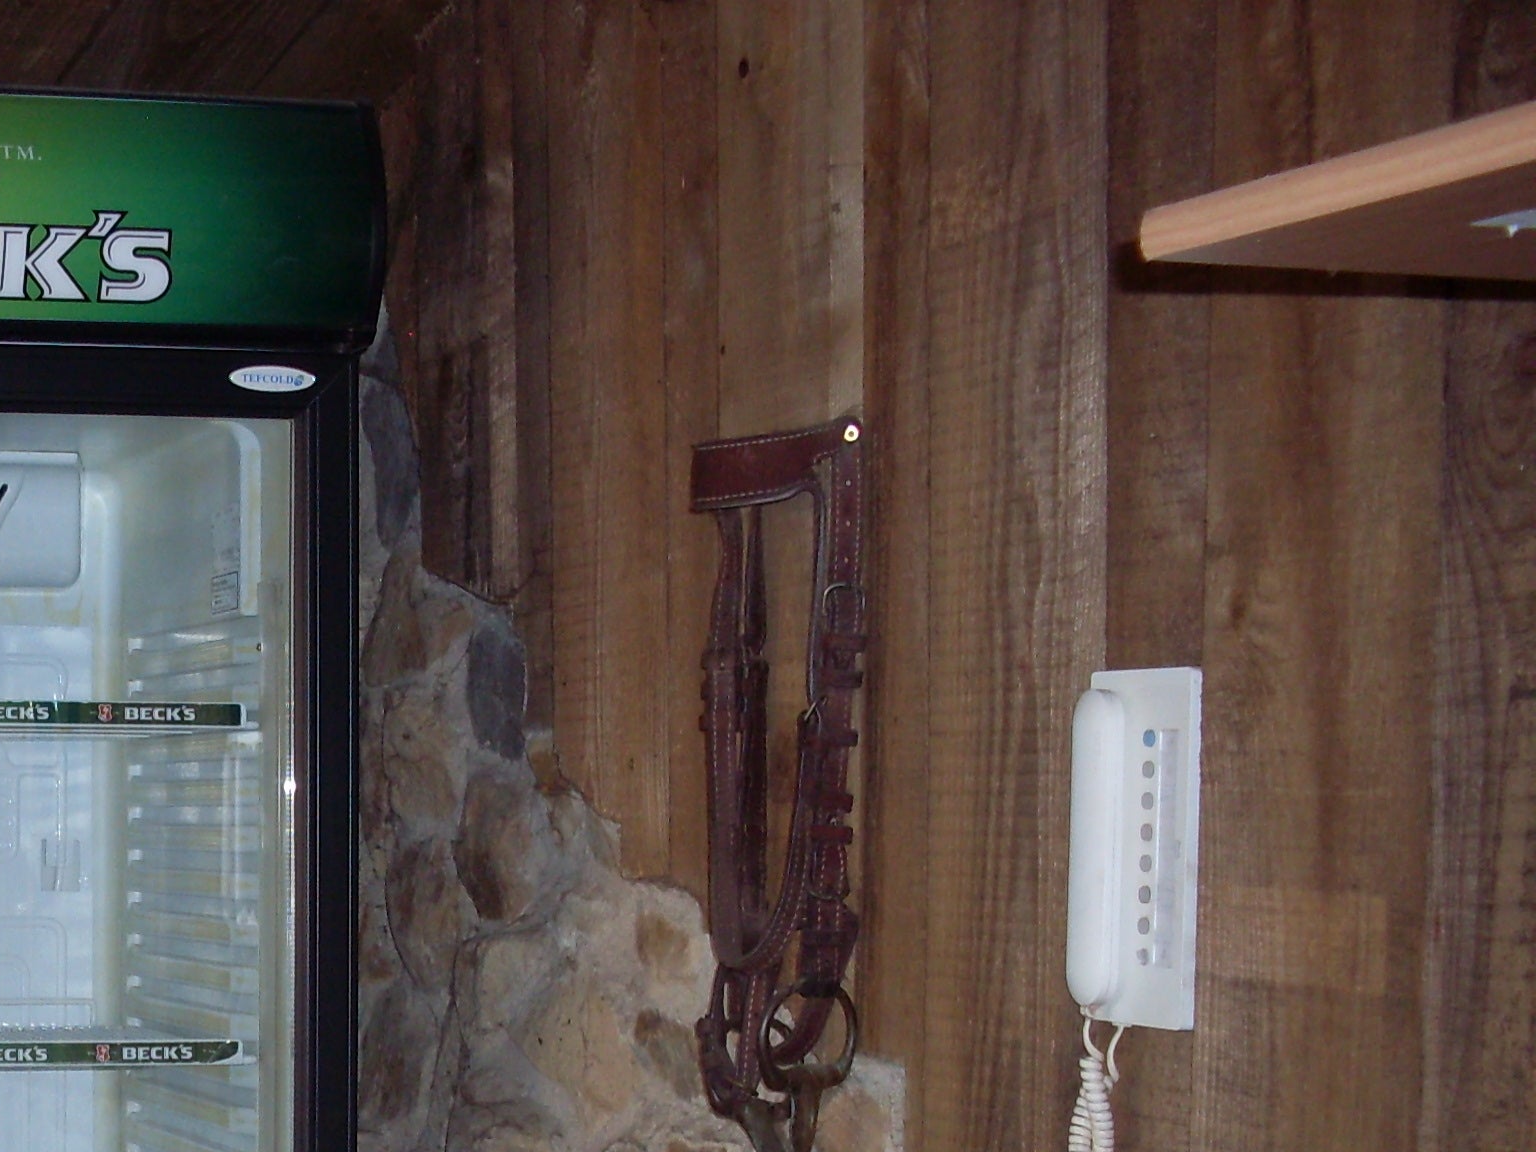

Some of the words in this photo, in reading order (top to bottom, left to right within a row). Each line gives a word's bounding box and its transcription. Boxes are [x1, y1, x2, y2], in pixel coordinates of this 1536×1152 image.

[0, 144, 42, 161] TM.
[124, 705, 196, 721] BECK'S
[122, 1044, 193, 1061] BECK'S
